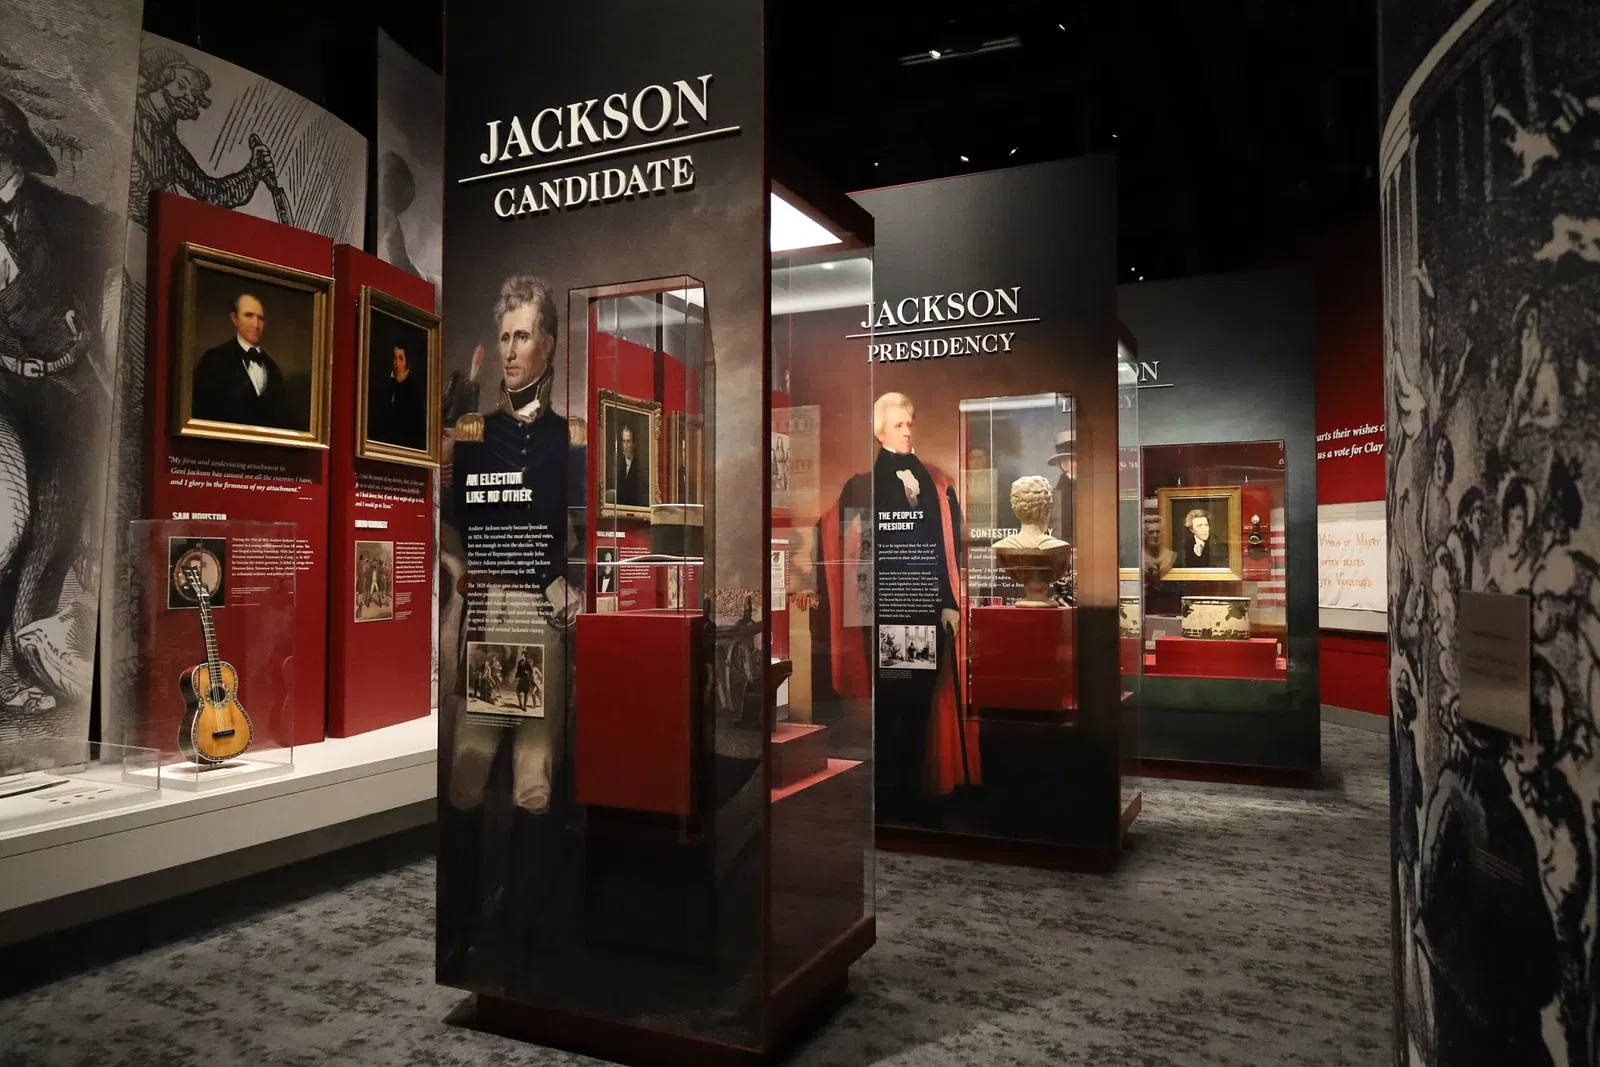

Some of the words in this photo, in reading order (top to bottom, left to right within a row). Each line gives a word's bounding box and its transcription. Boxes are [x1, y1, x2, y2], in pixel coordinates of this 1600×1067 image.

[480, 74, 712, 164] JACKSON
[494, 155, 694, 218] CANDIDATE
[861, 287, 1021, 329] JACKSON
[868, 333, 1015, 362] PRESIDENCY
[1333, 428, 1351, 439] their
[1353, 424, 1378, 435] wishes
[1334, 448, 1350, 457] vote
[1350, 444, 1363, 458] for
[1364, 442, 1383, 454] Clay
[466, 474, 479, 486] AN
[480, 472, 523, 485] ELECTION
[250, 483, 256, 491] of
[266, 485, 301, 493] attachment."
[466, 490, 486, 503] LIKE
[487, 490, 500, 503] NO
[502, 489, 532, 502] OTHER
[172, 512, 189, 520] SAM
[192, 512, 226, 520] HOUSTON
[878, 512, 891, 520] THE
[892, 511, 924, 519] PEOPLE'S
[879, 522, 914, 530] PRESIDENT
[971, 529, 1017, 538] CONTESTED
